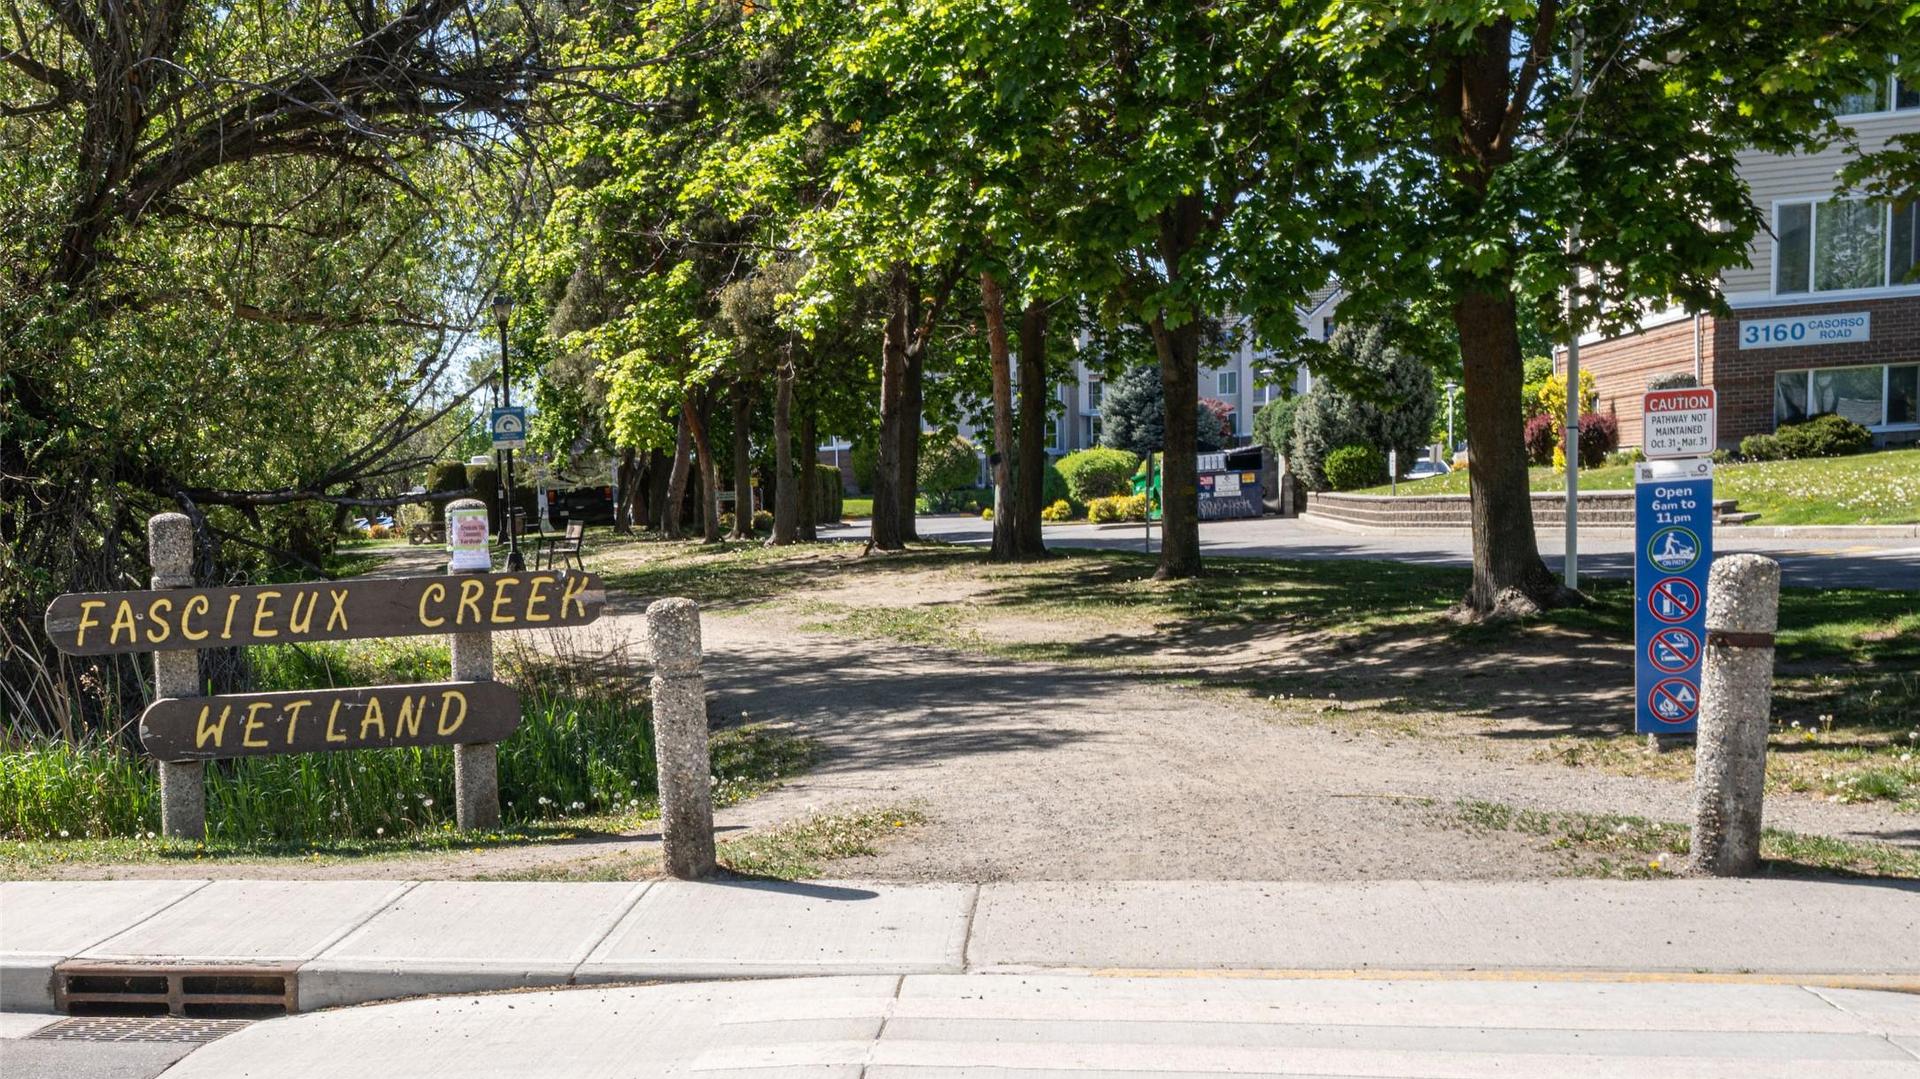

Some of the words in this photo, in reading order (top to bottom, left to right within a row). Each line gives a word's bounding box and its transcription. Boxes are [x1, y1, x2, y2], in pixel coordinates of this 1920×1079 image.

[1745, 322, 1806, 344] 3160
[1808, 317, 1865, 330] CASORSO
[1819, 329, 1853, 340] ROAD
[1649, 396, 1709, 411] CAUTION
[1651, 414, 1688, 425] PATHWAY
[1691, 413, 1707, 423] NOT
[1655, 425, 1703, 436] MAINTAINED
[1651, 439, 1666, 449] Oct.
[1668, 438, 1676, 448] 31
[1682, 438, 1698, 447] Mar.
[1699, 437, 1707, 446] 31
[1655, 487, 1693, 500] Open
[1651, 500, 1678, 511] 6am
[1681, 500, 1696, 509] to
[1656, 512, 1692, 524] 11pm
[1662, 559, 1672, 567] ON
[1672, 559, 1686, 567] PATH
[76, 589, 350, 647] FASCIEUX
[419, 574, 591, 628] CREEK
[196, 690, 470, 749] WETLAND
